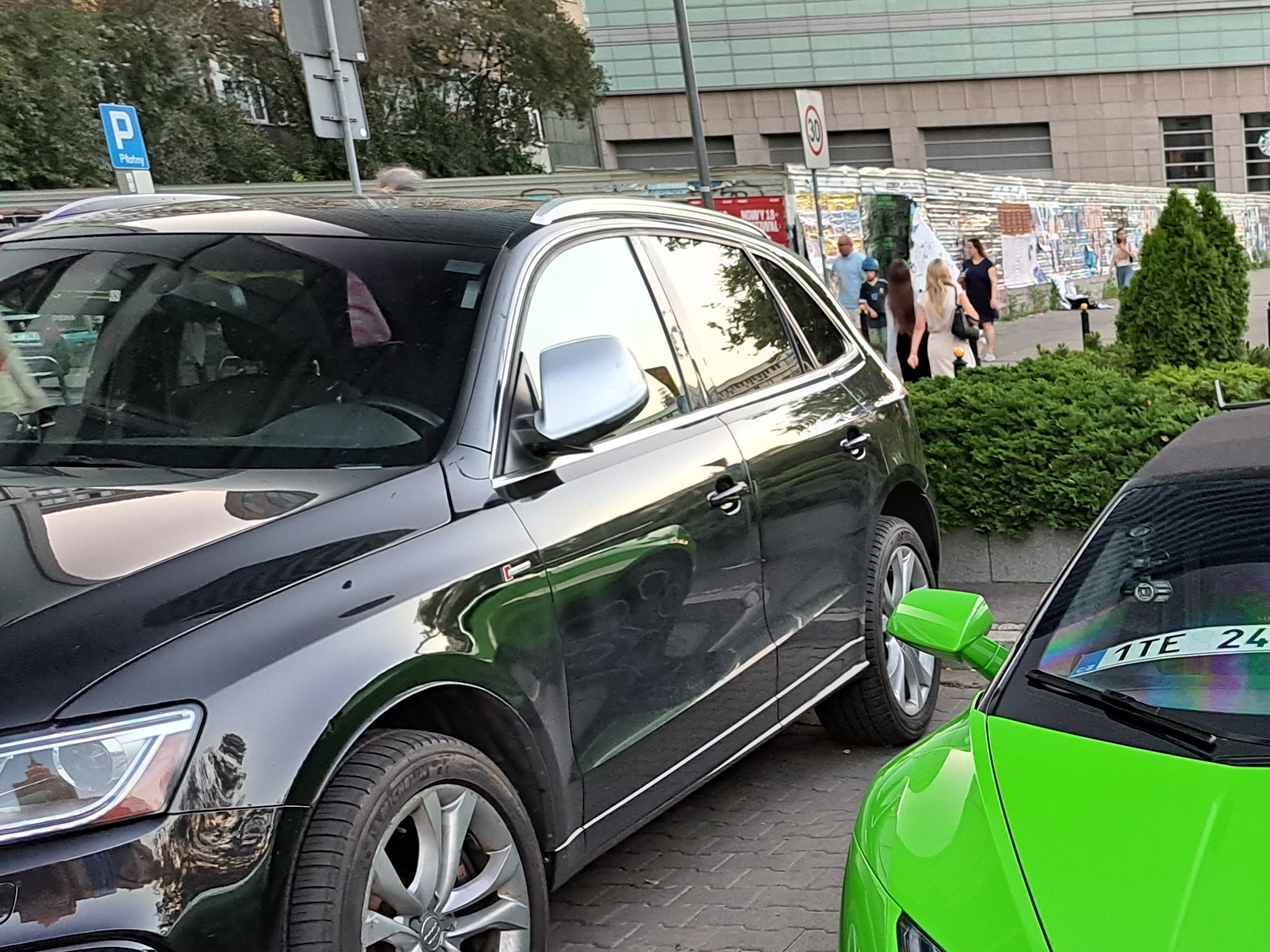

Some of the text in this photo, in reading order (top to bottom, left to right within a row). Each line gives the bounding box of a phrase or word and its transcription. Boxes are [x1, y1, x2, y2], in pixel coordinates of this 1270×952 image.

[109, 110, 135, 150] P
[808, 117, 821, 143] 30
[1114, 633, 1186, 662] 1TE
